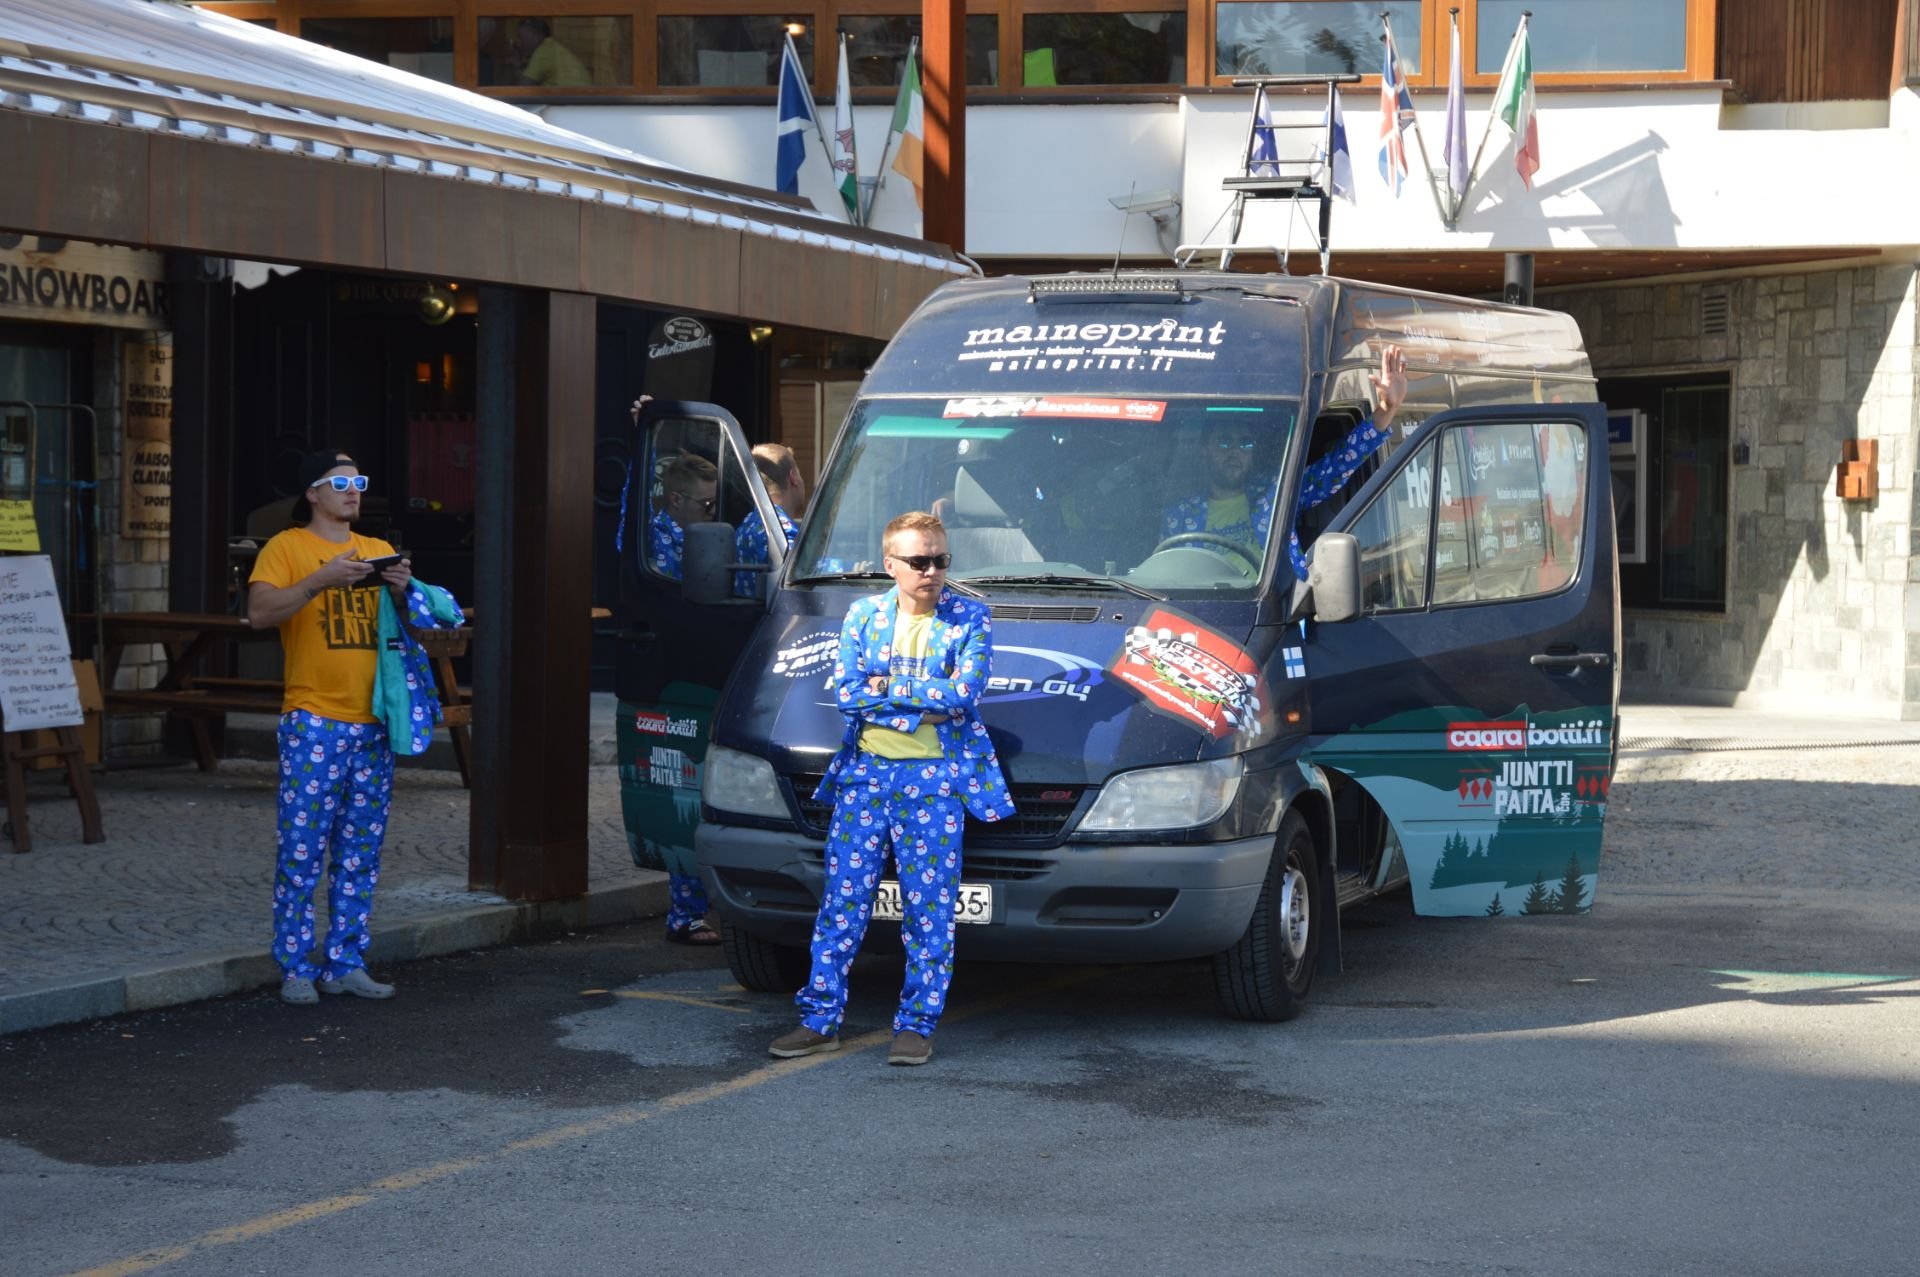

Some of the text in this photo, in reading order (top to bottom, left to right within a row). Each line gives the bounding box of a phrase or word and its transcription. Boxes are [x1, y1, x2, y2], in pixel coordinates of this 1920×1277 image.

[963, 318, 1227, 348] maineprint
[989, 354, 1175, 372] maineprint.fi
[790, 649, 839, 670] Antt
[1450, 719, 1603, 746] caara botti.fi
[650, 745, 681, 769] JUNTTI
[1495, 760, 1573, 787] JUNTTI
[1494, 788, 1556, 815] PAITA
